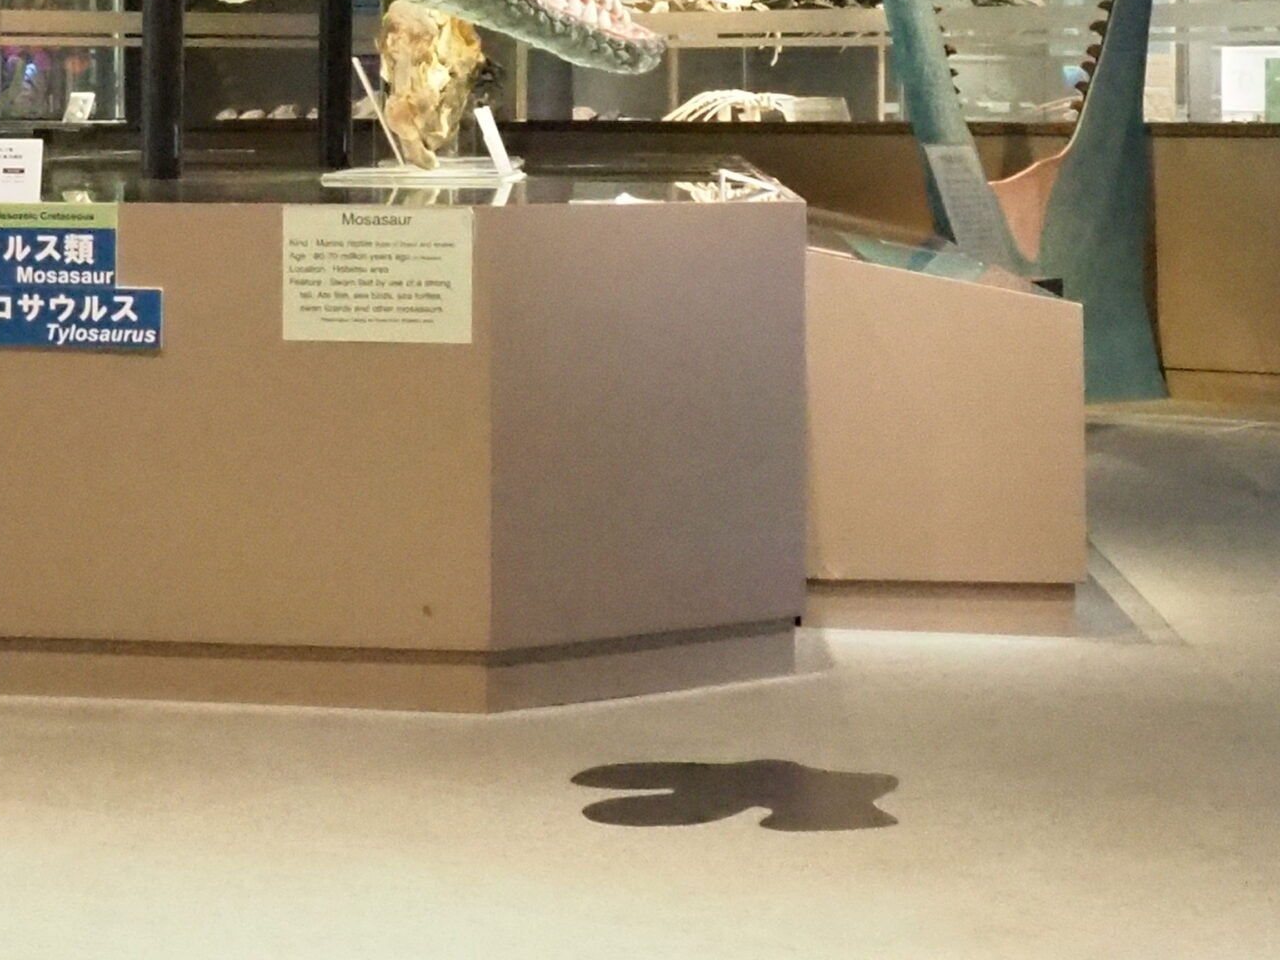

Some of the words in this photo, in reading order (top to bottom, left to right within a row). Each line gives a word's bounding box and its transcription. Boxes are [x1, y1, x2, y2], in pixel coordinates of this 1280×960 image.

[40, 211, 95, 221] Cretaceous
[341, 212, 412, 226] Mosasaur
[16, 265, 114, 285] Mosasaur
[46, 324, 157, 345] Tylosaurus
